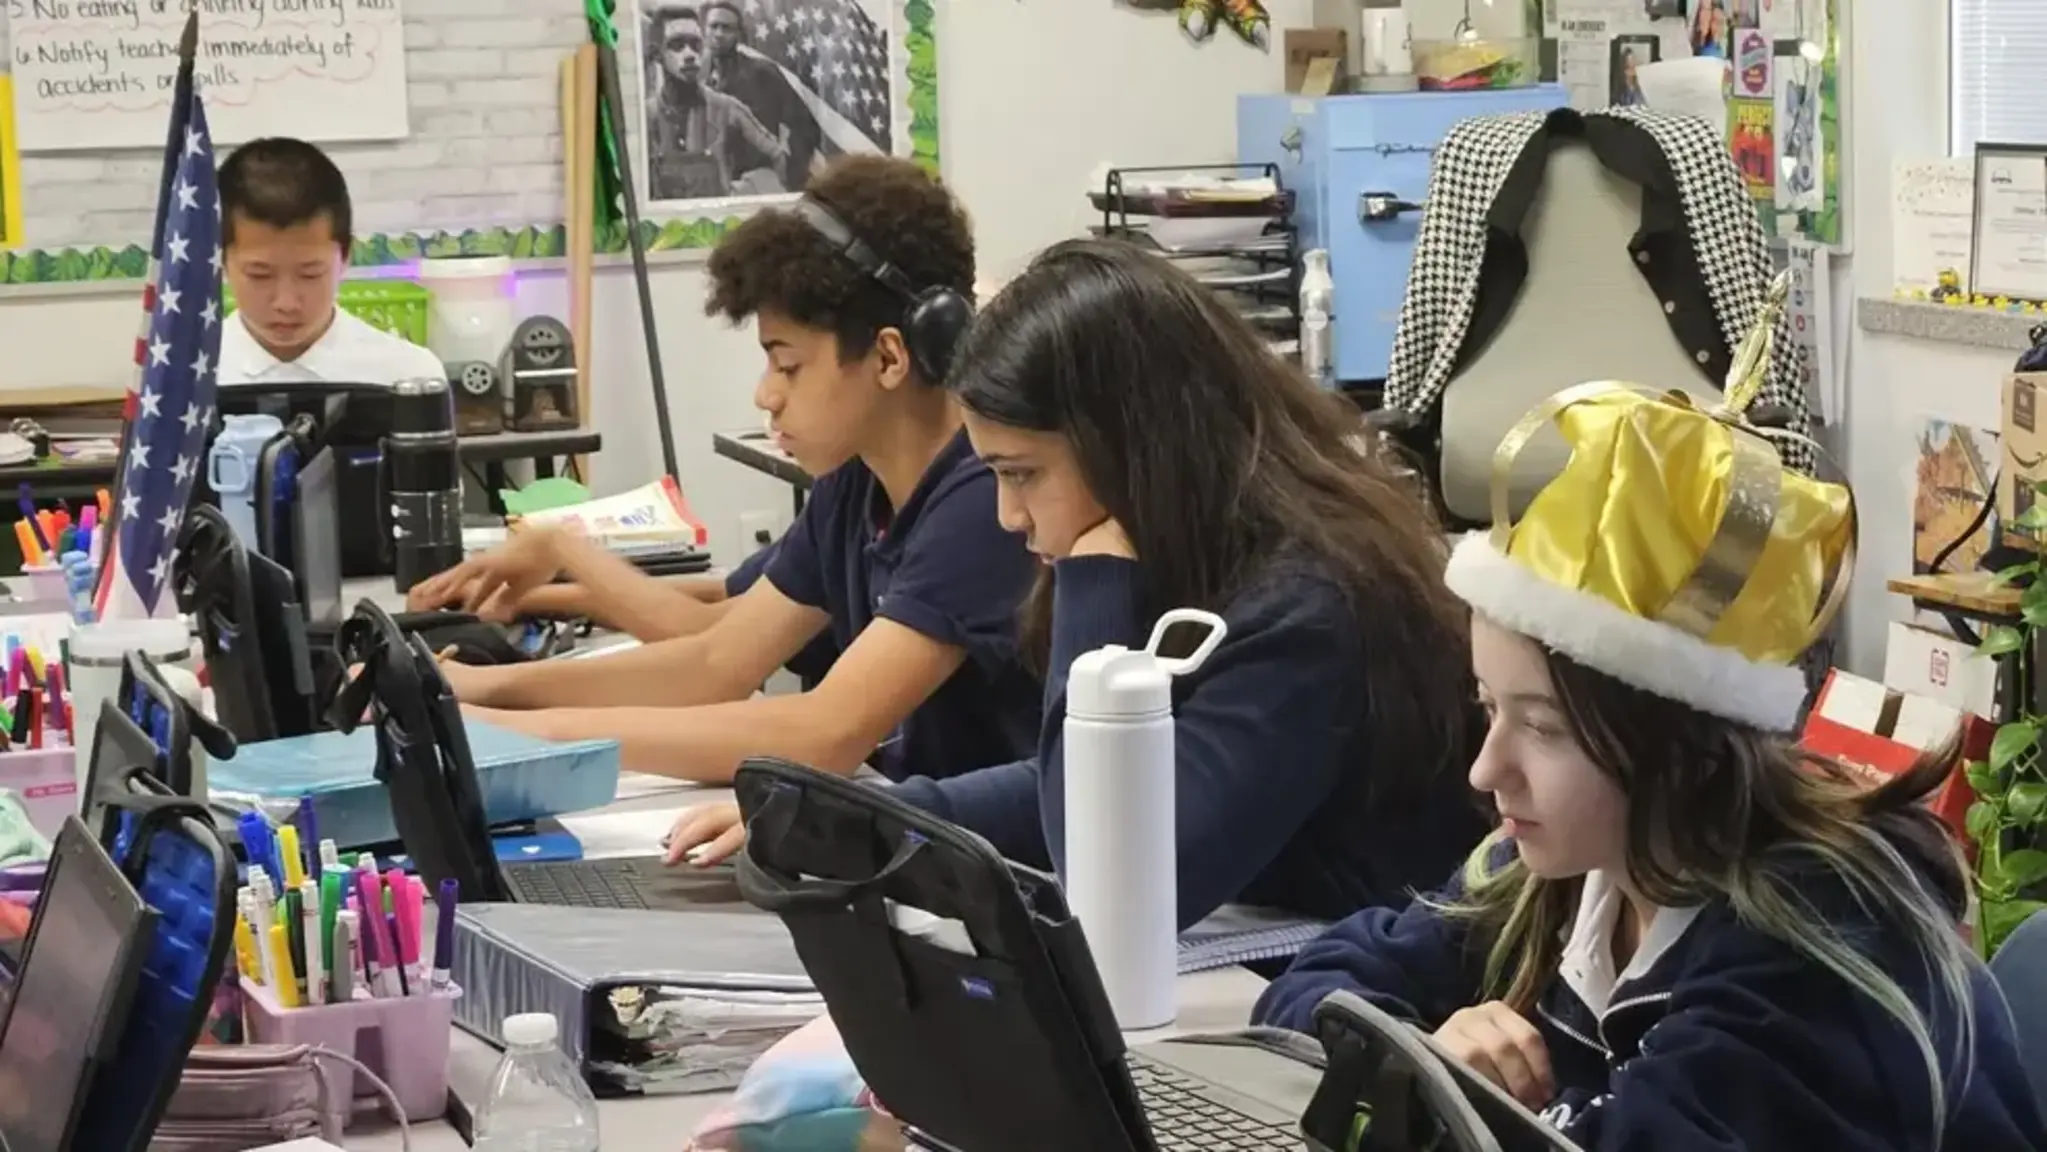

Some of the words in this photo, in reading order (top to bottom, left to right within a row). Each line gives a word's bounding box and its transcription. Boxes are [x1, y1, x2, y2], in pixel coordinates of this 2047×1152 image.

[32, 0, 69, 20] No
[77, 0, 139, 31] eating
[38, 40, 109, 74] Notify
[203, 33, 327, 68] immediately
[333, 32, 355, 58] of
[37, 71, 146, 99] accidents
